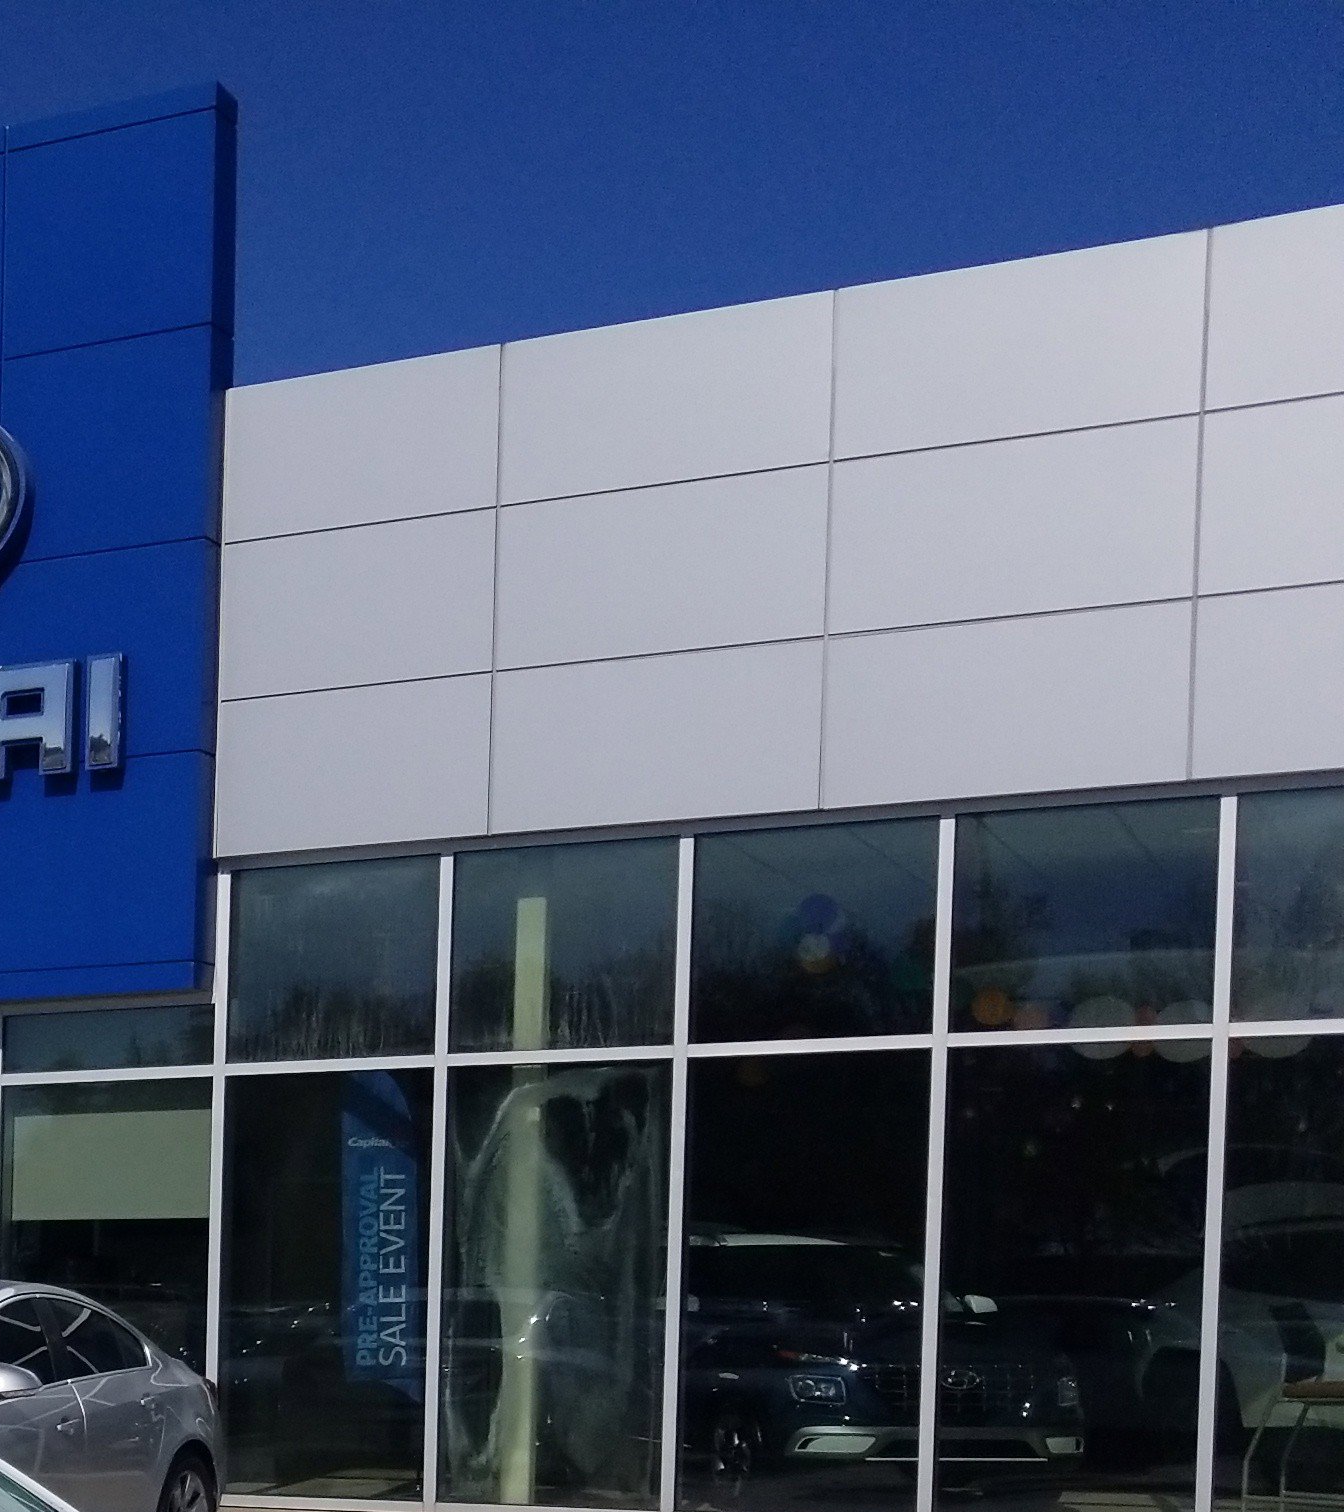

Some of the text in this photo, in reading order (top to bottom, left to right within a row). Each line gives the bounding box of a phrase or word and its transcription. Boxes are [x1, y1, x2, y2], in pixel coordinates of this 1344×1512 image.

[356, 1167, 379, 1366] PRE-APPROVAL
[378, 1166, 407, 1367] SALE EVENT
